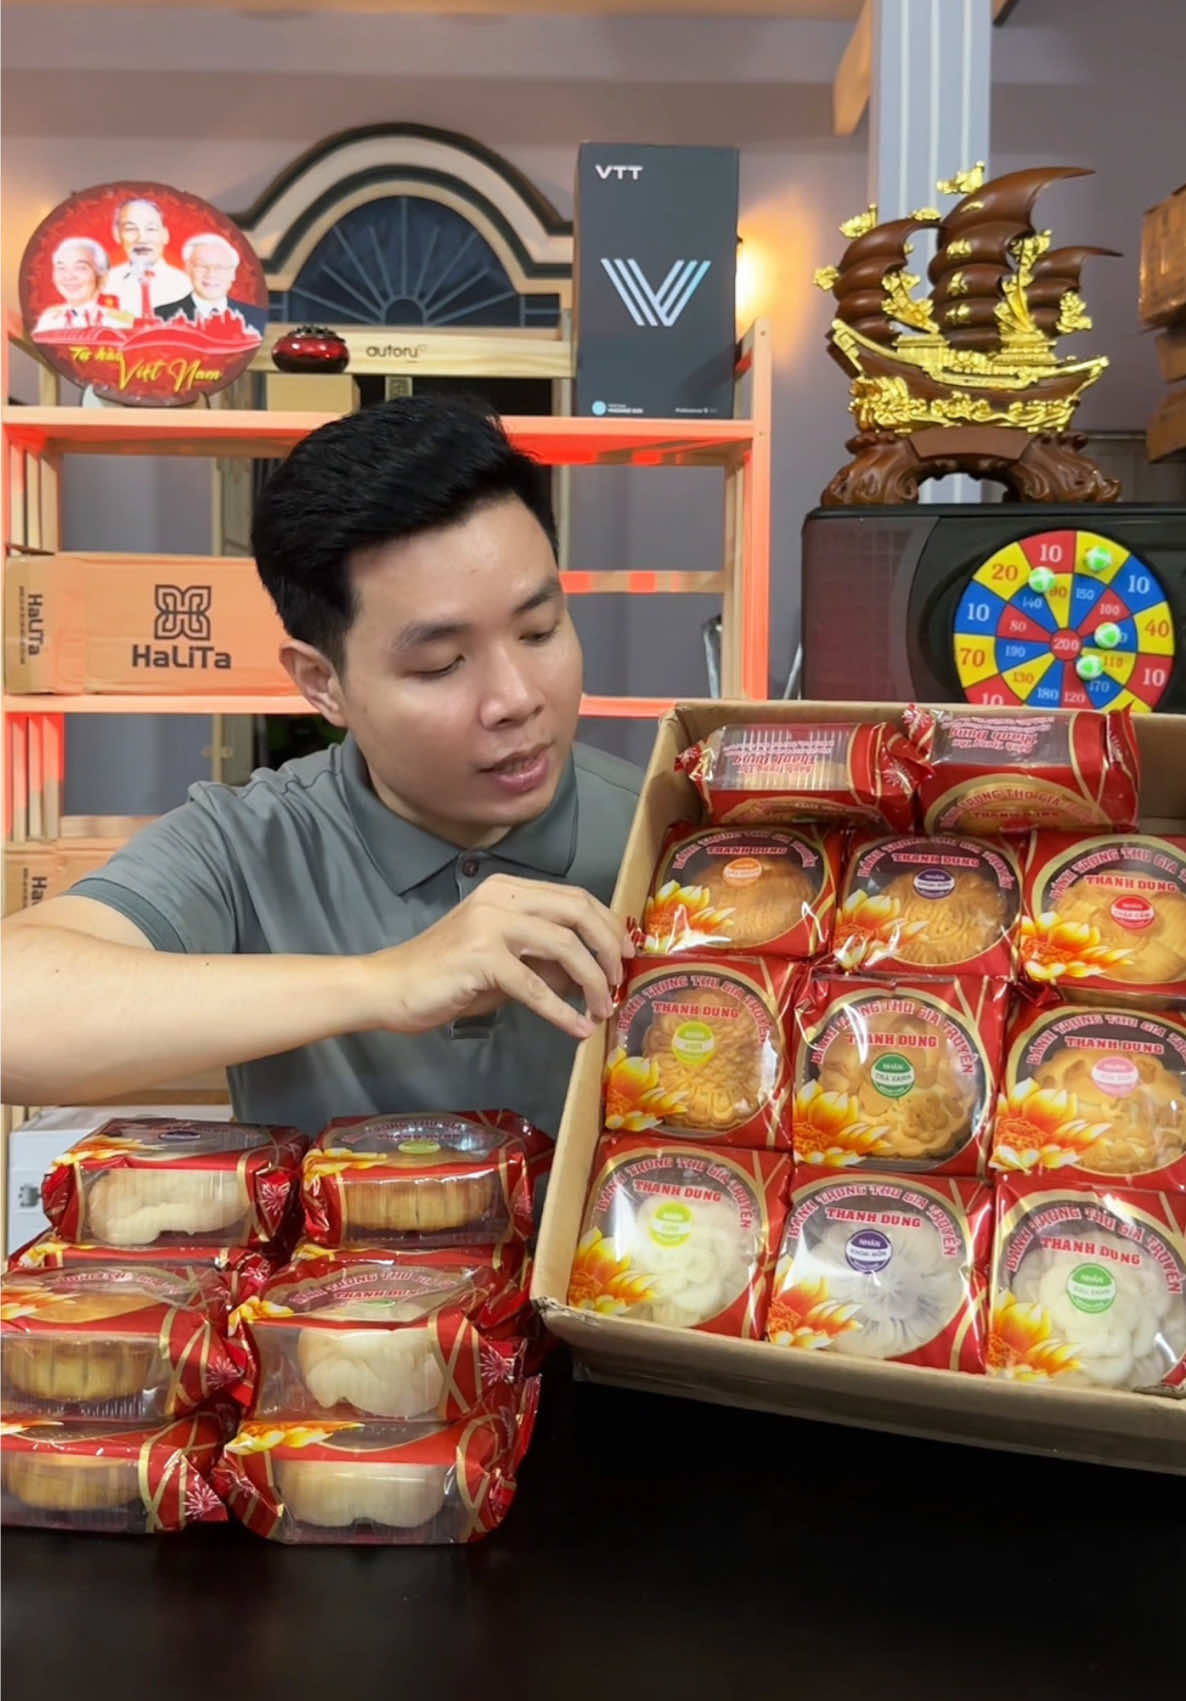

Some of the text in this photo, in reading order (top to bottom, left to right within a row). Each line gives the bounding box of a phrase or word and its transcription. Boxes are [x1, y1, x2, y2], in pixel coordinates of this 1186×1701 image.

[594, 164, 644, 180] VTT
[366, 344, 419, 358] autoru
[168, 358, 222, 393] Nam
[1040, 544, 1062, 562] 10
[991, 563, 1018, 581] 20
[1075, 588, 1095, 600] 150
[1127, 576, 1150, 594] 10
[967, 603, 990, 621] 10
[1100, 603, 1120, 617] 100
[1009, 620, 1027, 632] 80
[1144, 620, 1169, 638] 40
[1005, 646, 1026, 658] 190
[1053, 638, 1080, 651] 200
[960, 648, 985, 667] 70
[1013, 671, 1034, 684] 130
[1143, 669, 1165, 686] 10
[982, 693, 1004, 706] 10
[1038, 687, 1059, 700] 180
[1064, 691, 1086, 703] 120
[891, 853, 941, 865] THANH
[1071, 848, 1121, 875] TRUNG
[1085, 874, 1178, 893] THANH DUNG
[652, 1001, 741, 1020] THANH DUNG
[885, 1000, 915, 1015] THU
[916, 1005, 942, 1026] GIA
[897, 1034, 939, 1048] DUNG
[1064, 1036, 1121, 1051] THANH
[1121, 1040, 1165, 1056] DUNG
[632, 1179, 724, 1203] THANH DUNG
[815, 1184, 867, 1205] TRUNG
[869, 1184, 903, 1199] THU
[825, 1206, 923, 1229] THANH DUNG
[1029, 1206, 1082, 1233] TRUNG
[1040, 1236, 1143, 1268] THANH DUNG
